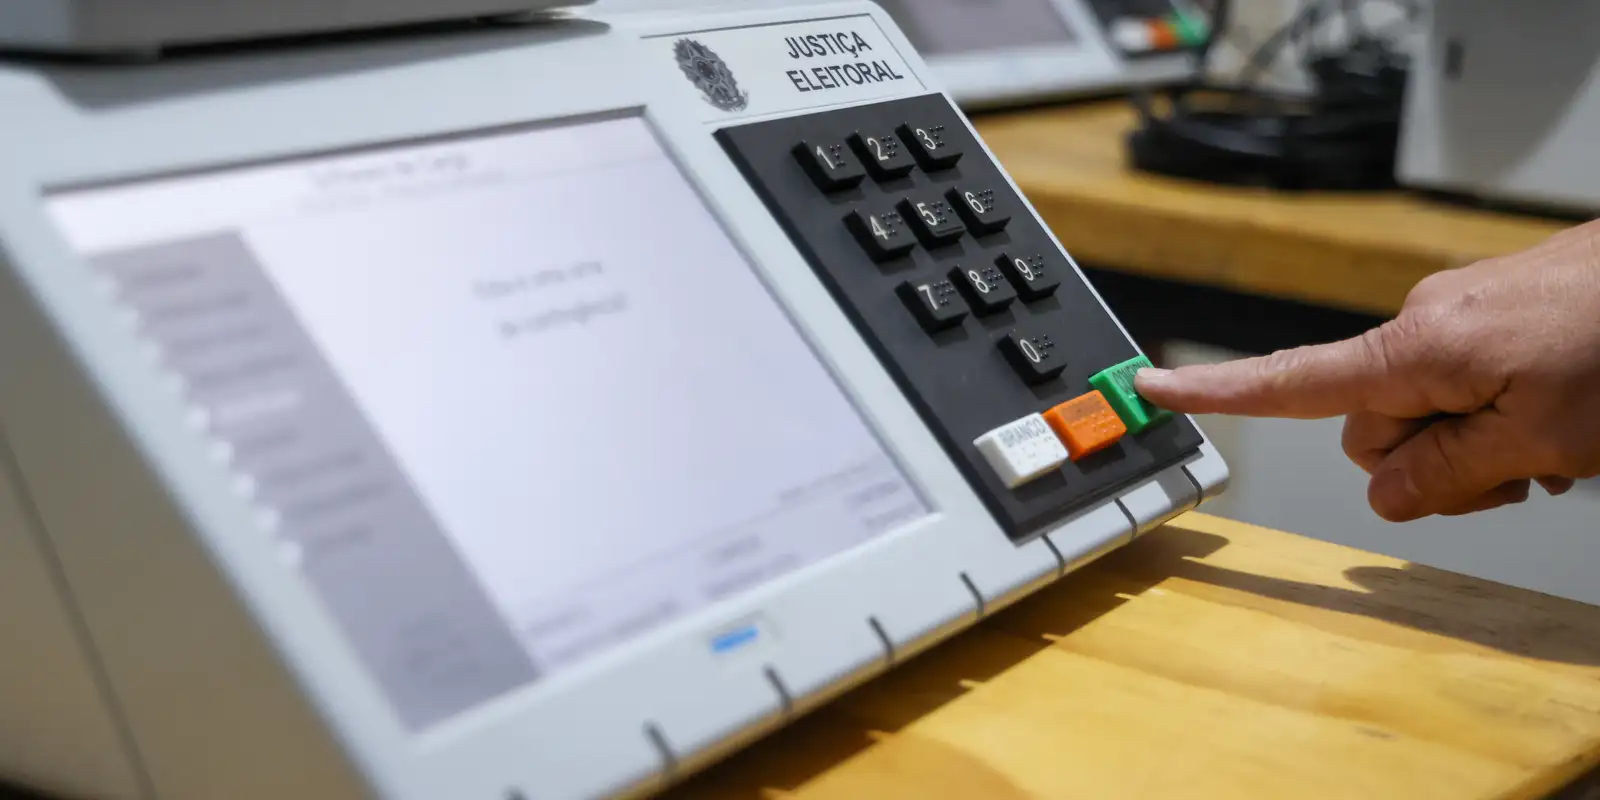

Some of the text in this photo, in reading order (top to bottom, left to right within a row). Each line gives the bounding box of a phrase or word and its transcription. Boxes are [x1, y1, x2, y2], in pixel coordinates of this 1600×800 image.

[784, 31, 872, 59] JUSTIÇA
[785, 59, 904, 92] ELEITORAL
[867, 137, 889, 160] 2
[916, 128, 936, 150] 3
[816, 145, 835, 169] 1
[916, 202, 937, 226] 5
[965, 191, 984, 214] 6
[870, 215, 889, 240] 4
[1014, 258, 1034, 281] 9
[968, 270, 989, 294] 8
[917, 284, 939, 310] 7
[1019, 339, 1041, 363] 0
[997, 417, 1047, 448] BRANCO
